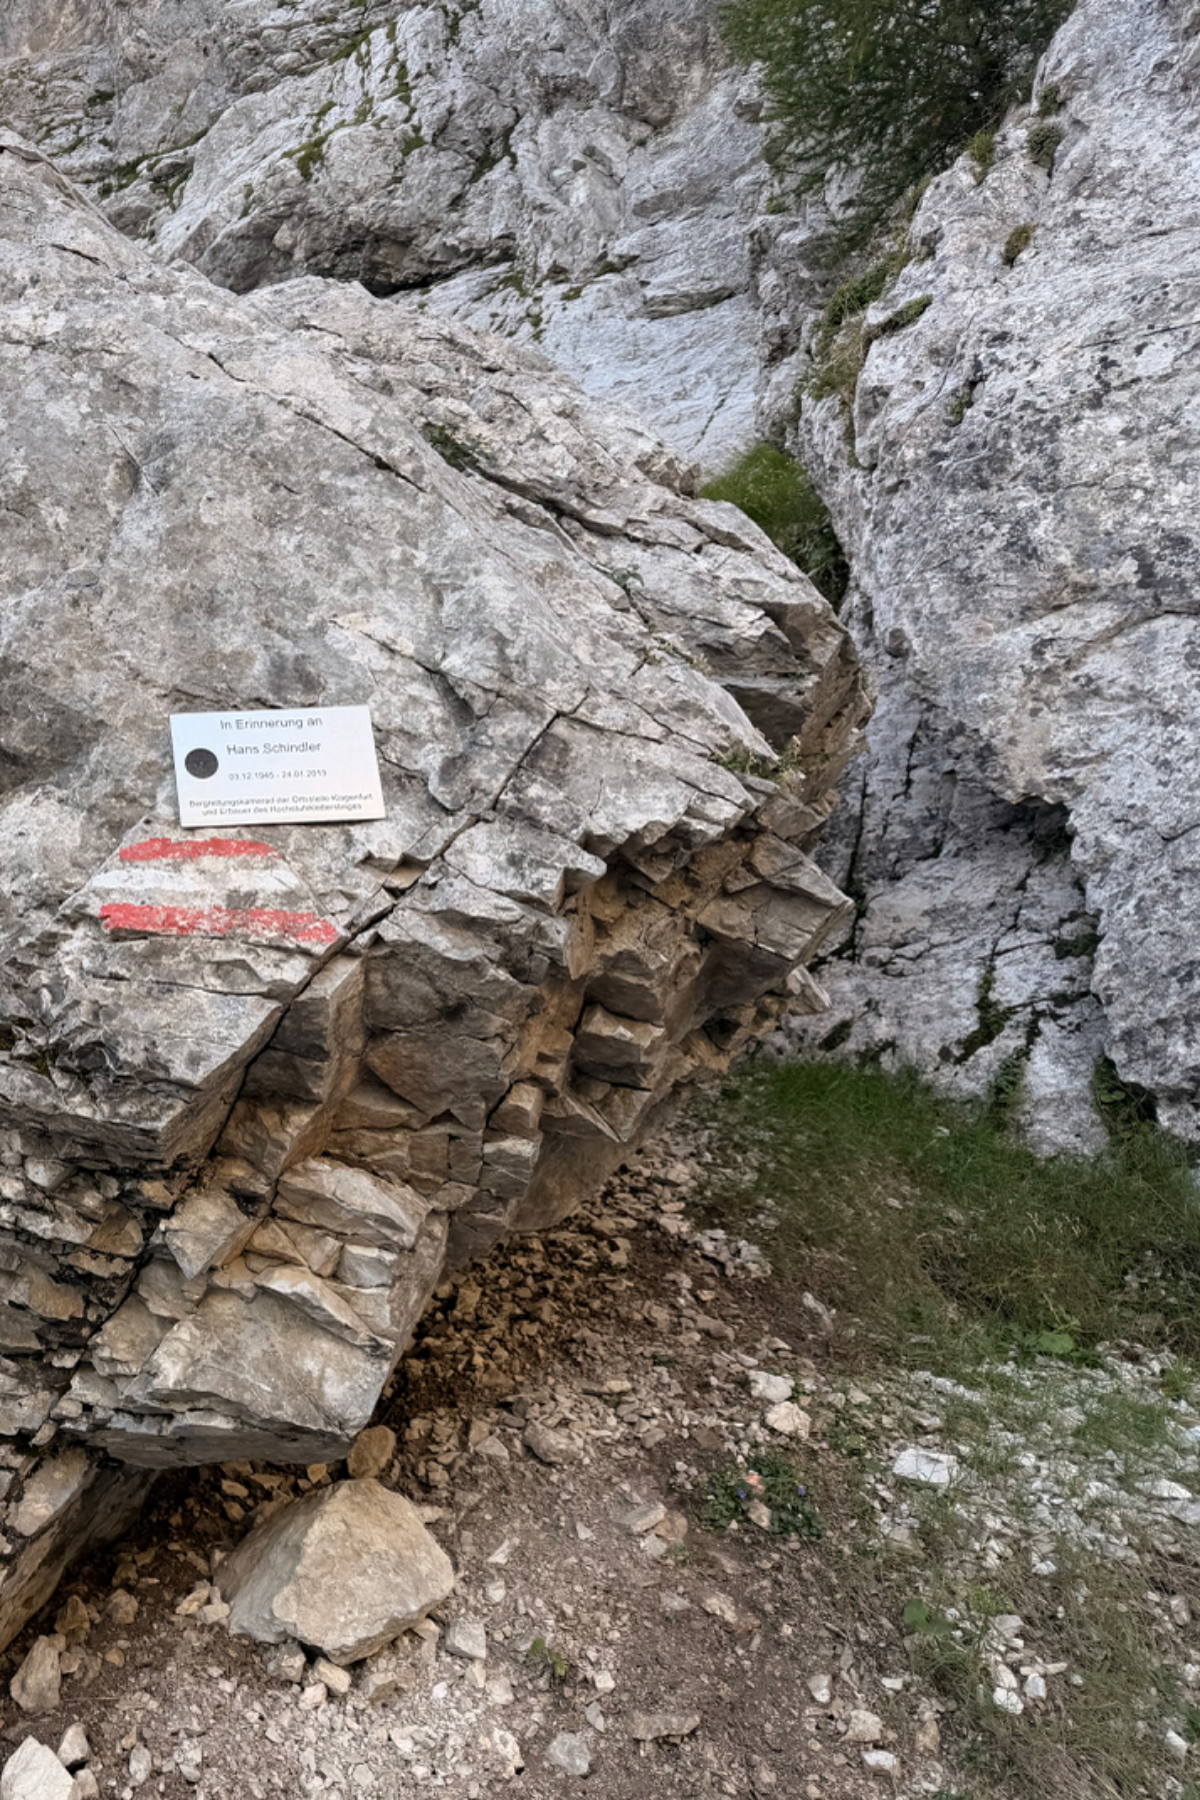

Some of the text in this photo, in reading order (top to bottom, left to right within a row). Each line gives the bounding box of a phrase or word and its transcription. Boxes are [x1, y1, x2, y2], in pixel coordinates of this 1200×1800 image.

[220, 717, 323, 730] In Erinnerung an
[226, 741, 321, 755] Hans Schindler
[331, 793, 373, 802] Klagenfurt
[202, 808, 217, 816] und
